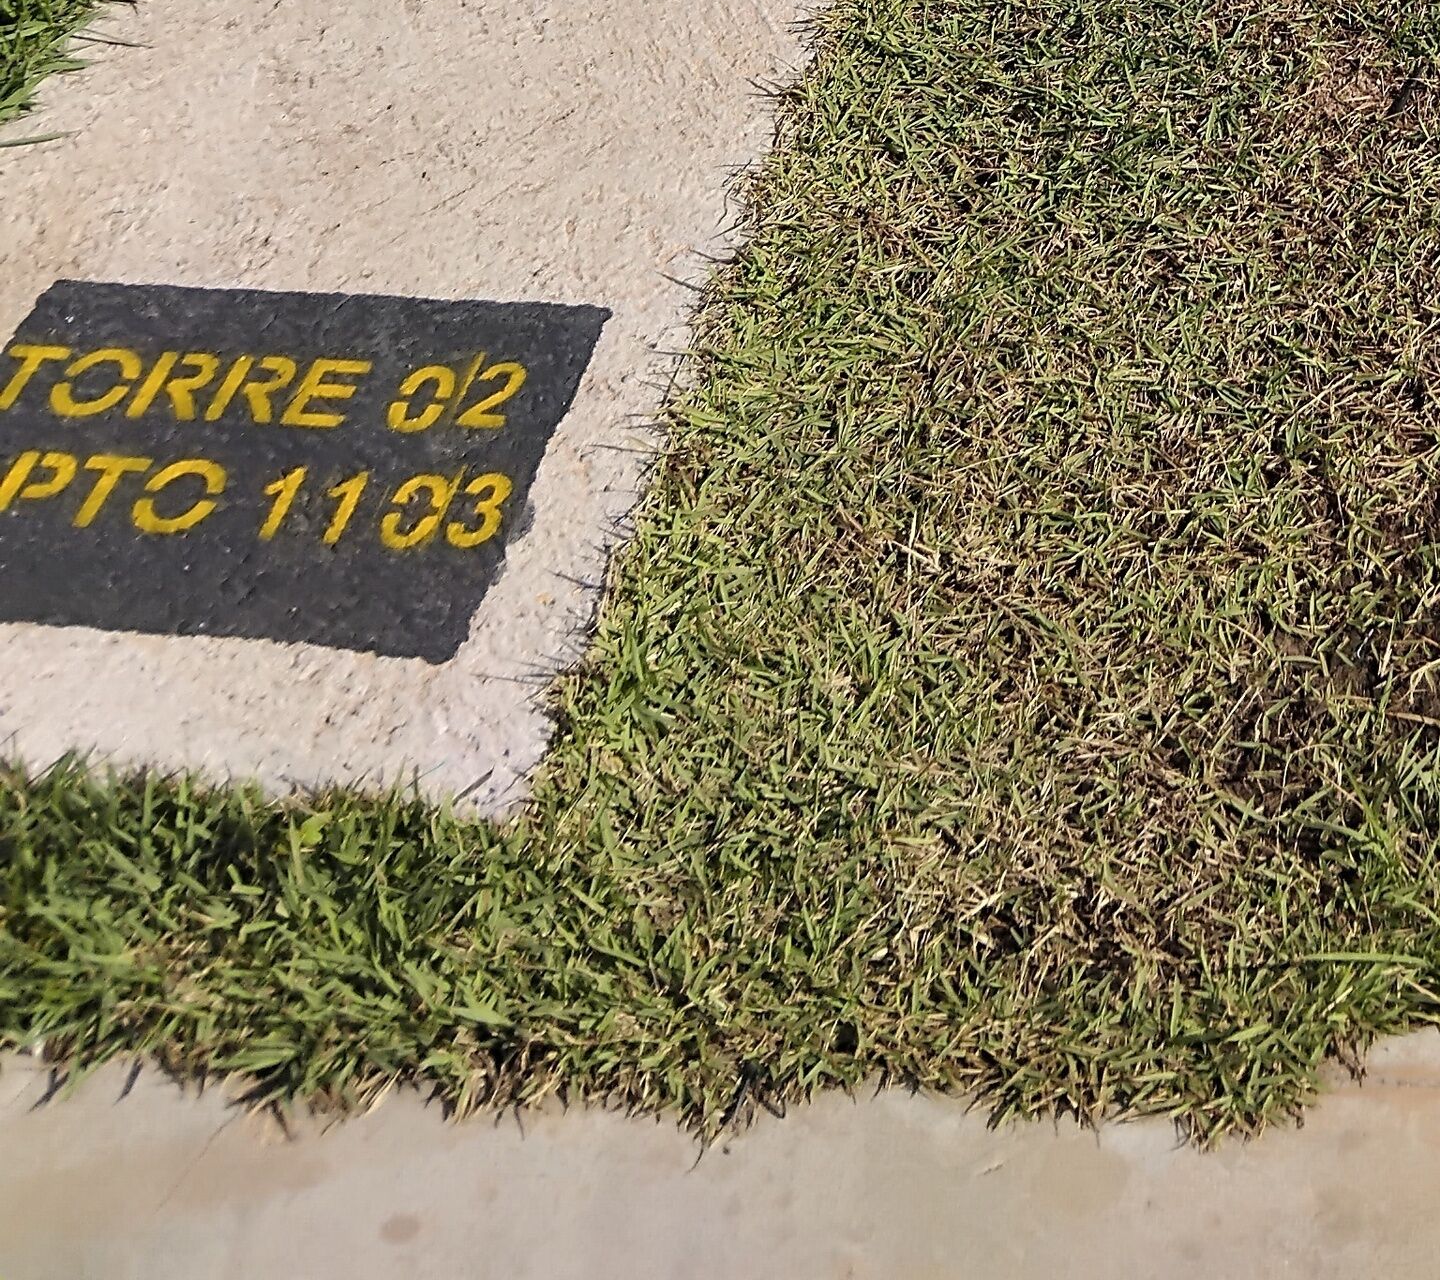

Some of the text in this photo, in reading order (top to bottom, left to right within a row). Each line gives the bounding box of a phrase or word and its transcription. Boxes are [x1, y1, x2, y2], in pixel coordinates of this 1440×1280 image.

[0, 342, 528, 434] TORRE 02
[0, 448, 513, 550] PTO 1103
